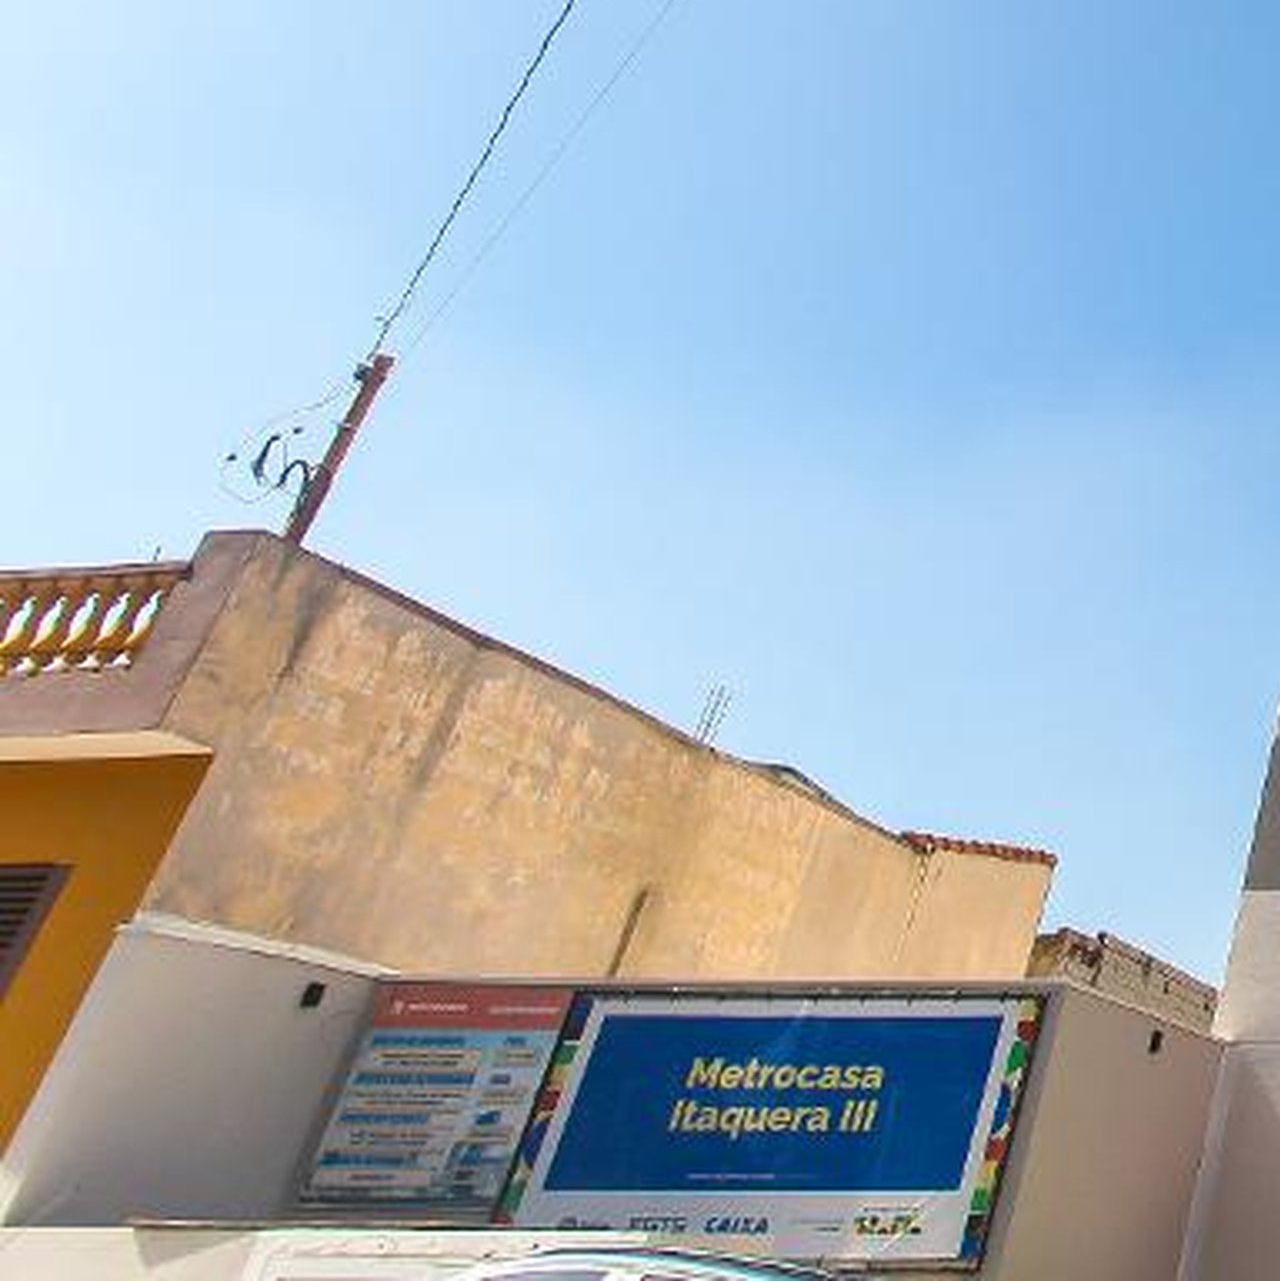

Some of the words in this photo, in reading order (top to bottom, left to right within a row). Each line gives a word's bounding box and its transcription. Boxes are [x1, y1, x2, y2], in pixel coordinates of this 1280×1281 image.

[686, 1057, 884, 1090] Metrocasa
[669, 1099, 830, 1139] Itaquera
[704, 1216, 770, 1234] CAIXA
